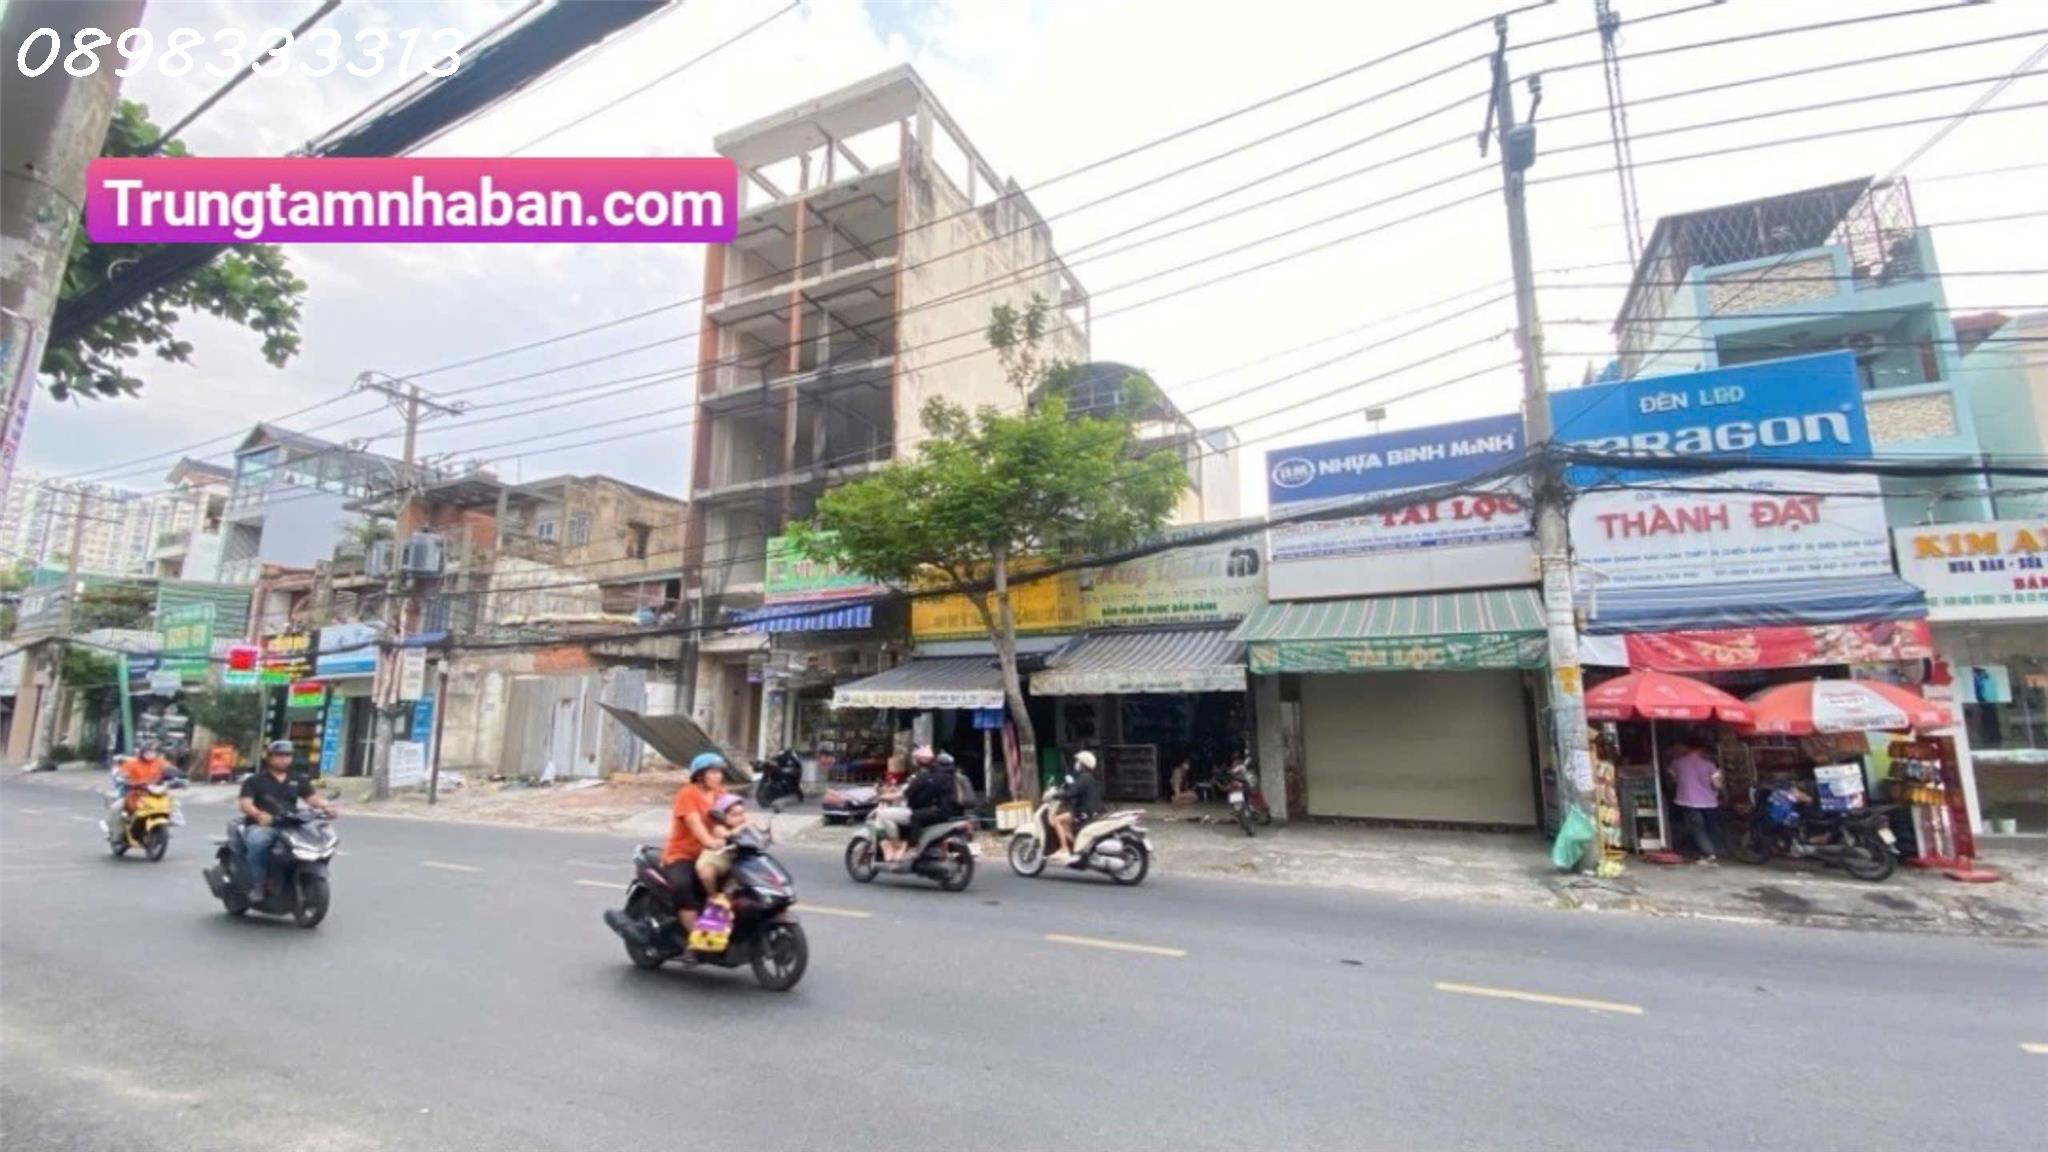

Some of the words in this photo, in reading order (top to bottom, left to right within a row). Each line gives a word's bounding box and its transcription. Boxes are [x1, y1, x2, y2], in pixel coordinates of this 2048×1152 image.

[1639, 391, 1688, 414] ĐÈN
[1318, 453, 1383, 476] NHỰA
[1596, 503, 1730, 539] THÀNH
[1749, 494, 1825, 532] ĐẠT
[1915, 532, 1998, 559] KIM
[2007, 527, 2048, 555] A
